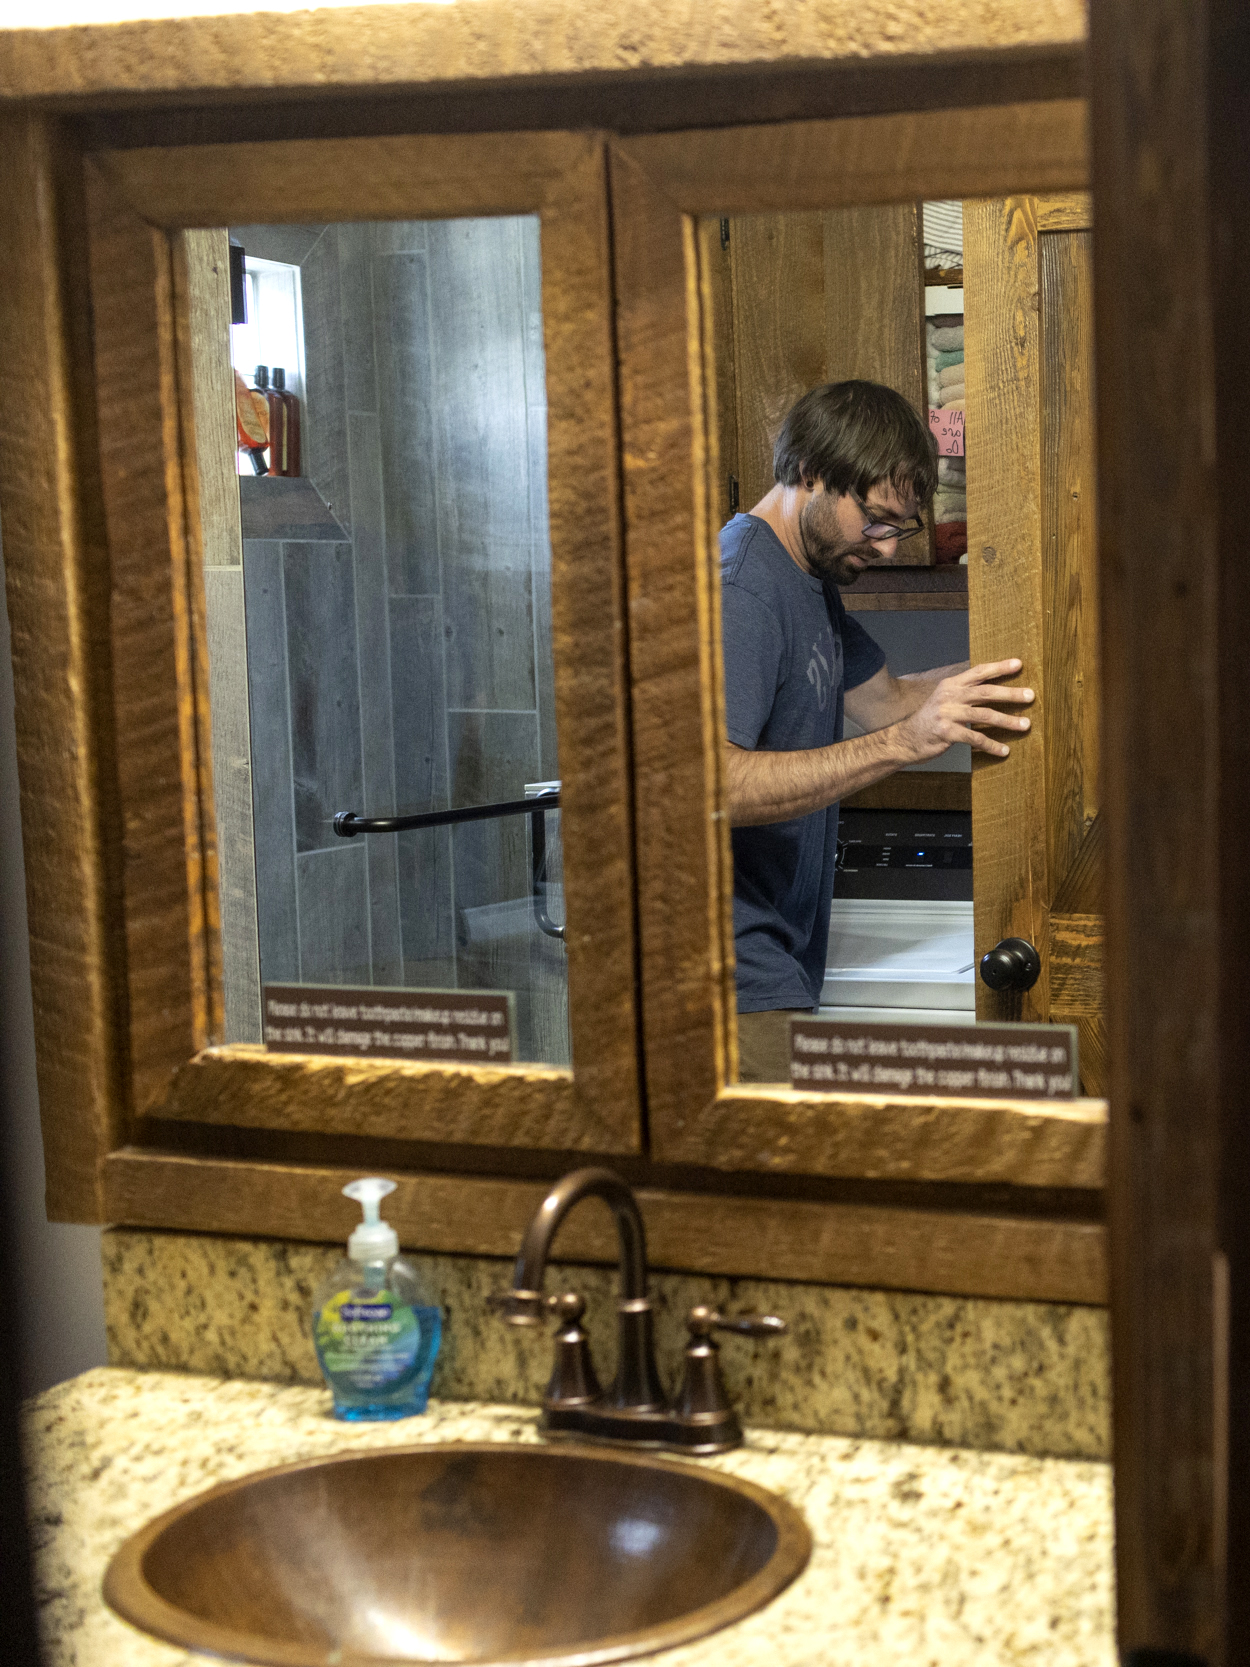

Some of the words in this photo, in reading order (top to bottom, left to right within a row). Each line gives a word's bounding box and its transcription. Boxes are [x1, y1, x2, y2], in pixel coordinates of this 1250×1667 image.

[267, 999, 297, 1018] Please
[300, 1001, 311, 1019] do
[312, 1002, 328, 1019] not
[265, 1025, 282, 1042] the
[336, 1028, 372, 1051] damage
[373, 1030, 391, 1047] the
[457, 1031, 487, 1051] Thank
[794, 1033, 828, 1053] Please
[831, 1036, 844, 1055] do
[845, 1037, 866, 1056] not
[790, 1061, 811, 1080] the
[873, 1064, 914, 1090] damage
[914, 1066, 935, 1086] the
[1011, 1068, 1046, 1091] Thank
